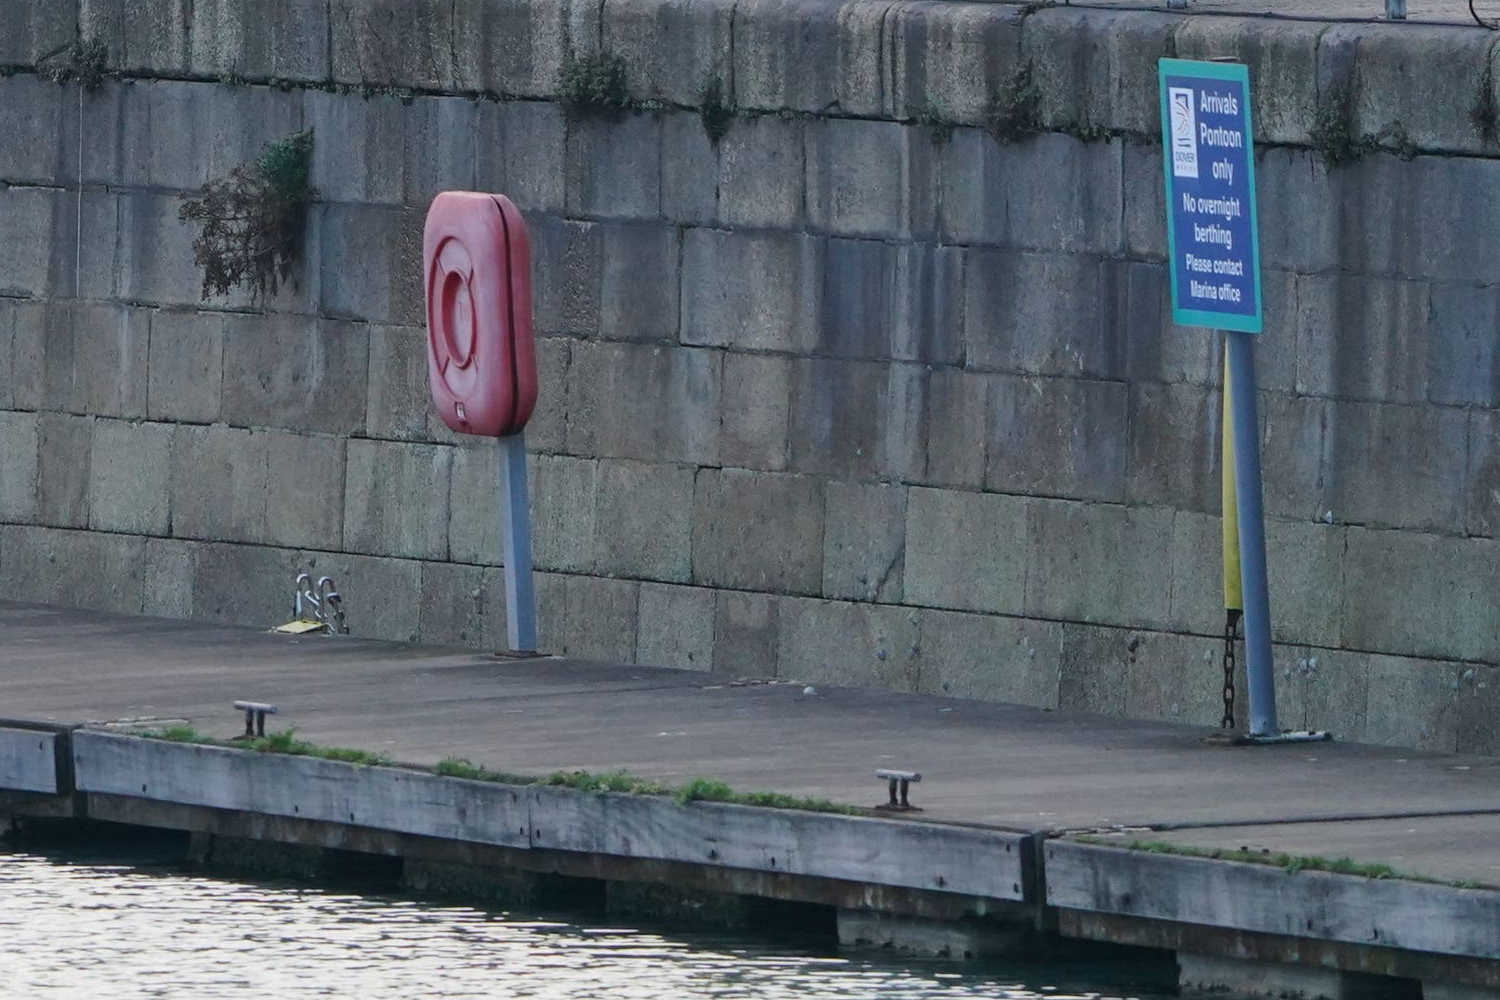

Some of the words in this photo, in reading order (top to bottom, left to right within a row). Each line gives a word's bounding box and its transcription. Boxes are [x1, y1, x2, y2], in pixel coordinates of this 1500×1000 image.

[1200, 90, 1238, 116] Arrivals
[1200, 122, 1242, 148] Pontoon
[1212, 158, 1233, 186] only
[1182, 192, 1197, 213] No
[1197, 196, 1241, 221] overnight
[1194, 222, 1233, 250] berthing
[1185, 253, 1212, 273] Please
[1213, 259, 1244, 276] contact
[1190, 280, 1218, 300] Marina
[1218, 283, 1241, 302] office
